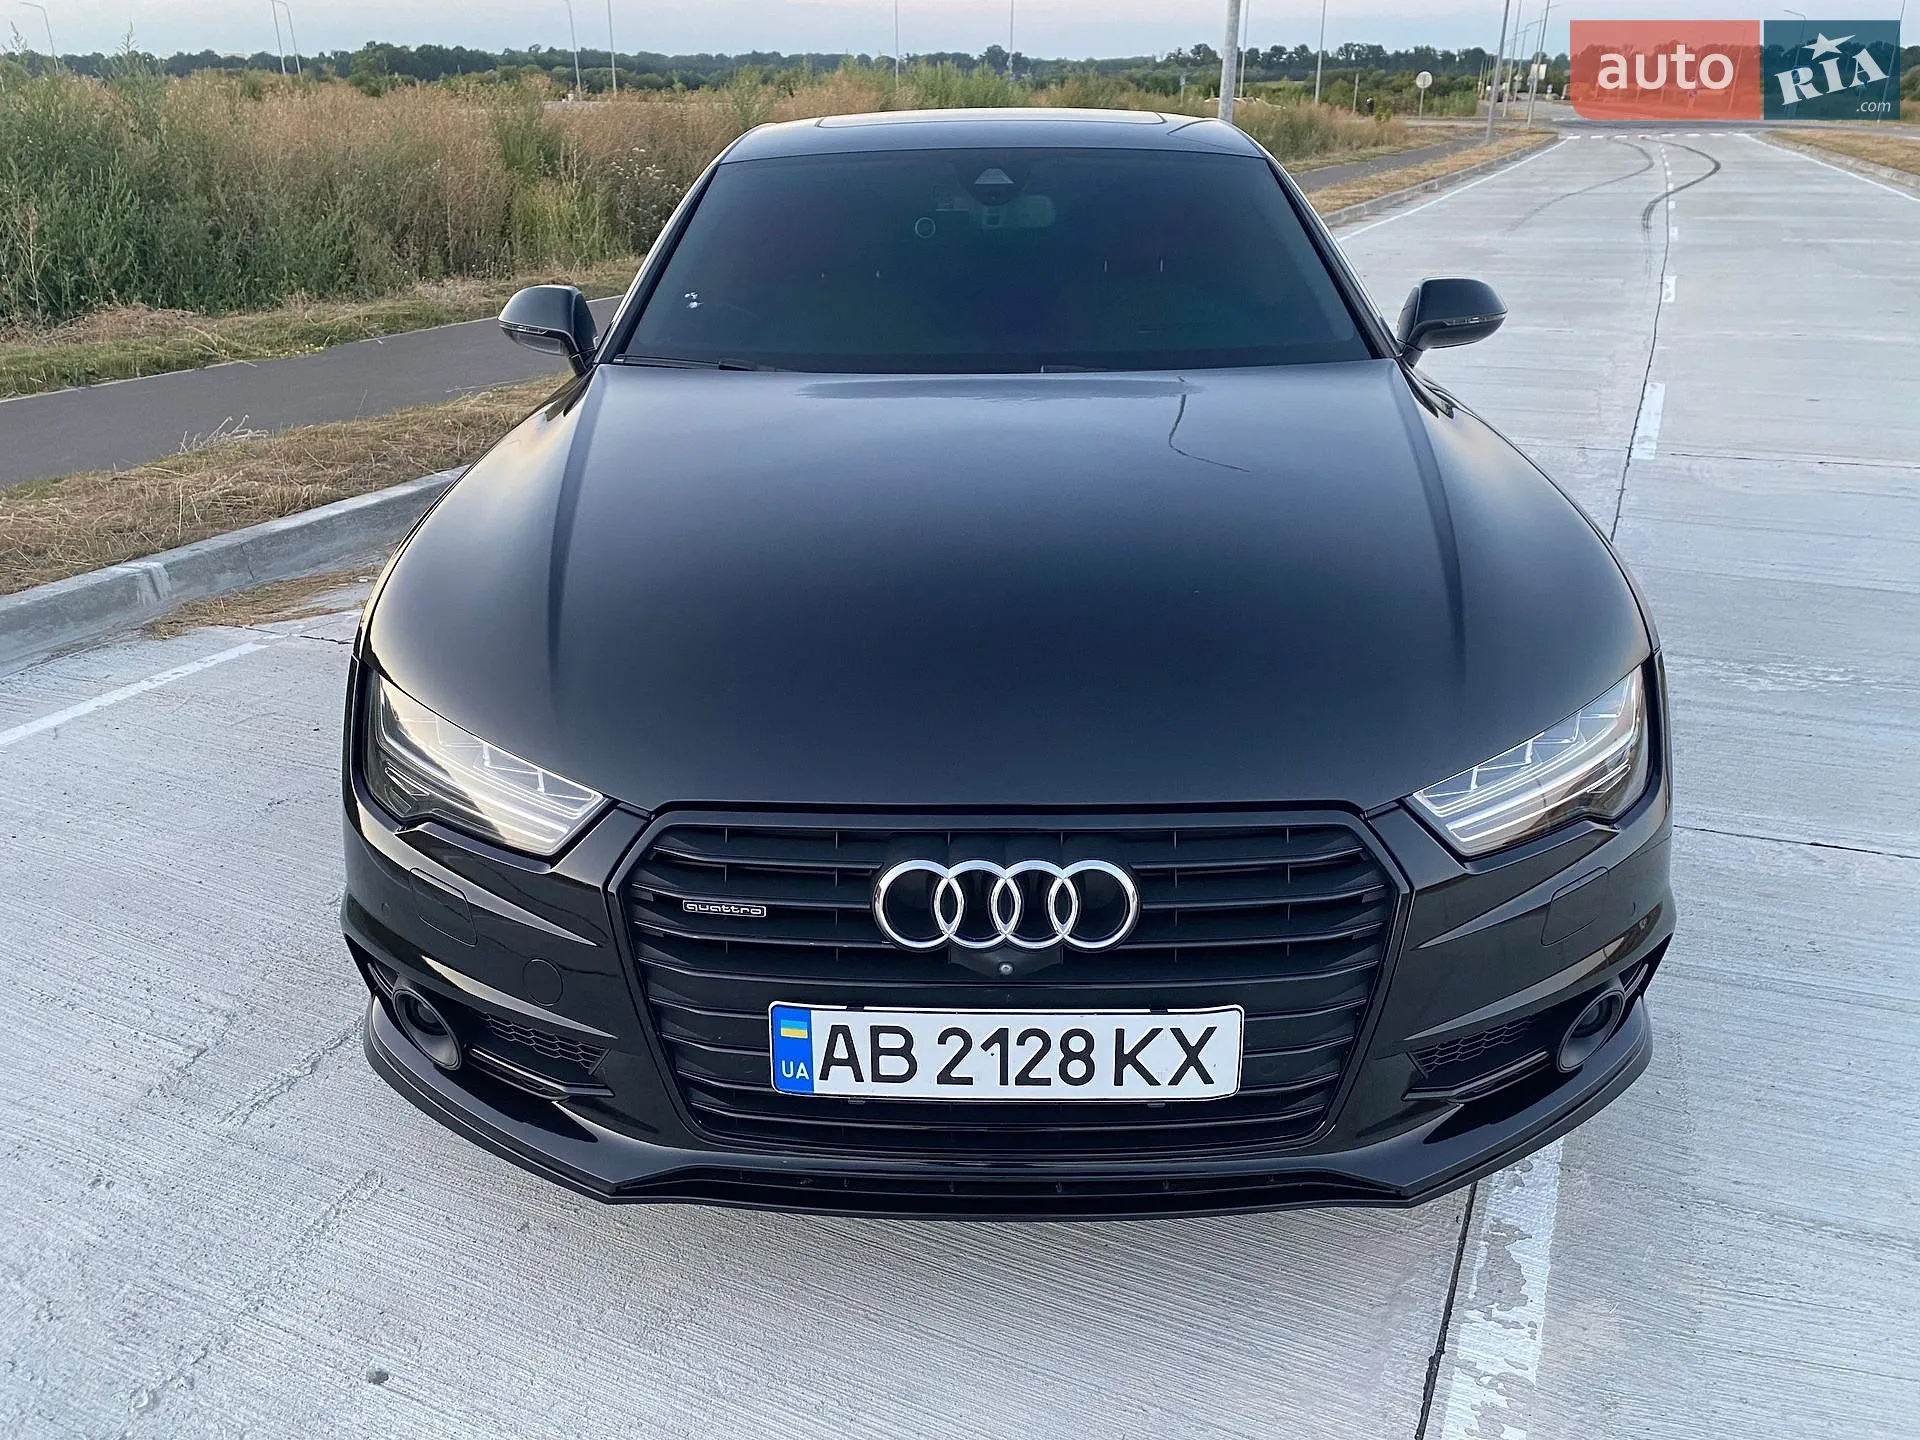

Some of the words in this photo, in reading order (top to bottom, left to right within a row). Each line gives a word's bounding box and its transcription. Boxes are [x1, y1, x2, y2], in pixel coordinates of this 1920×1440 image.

[686, 903, 762, 915] quattro
[819, 1025, 918, 1083] AB
[936, 1028, 1095, 1086] 2128
[1113, 1027, 1218, 1086] KX
[781, 1060, 809, 1080] UA
